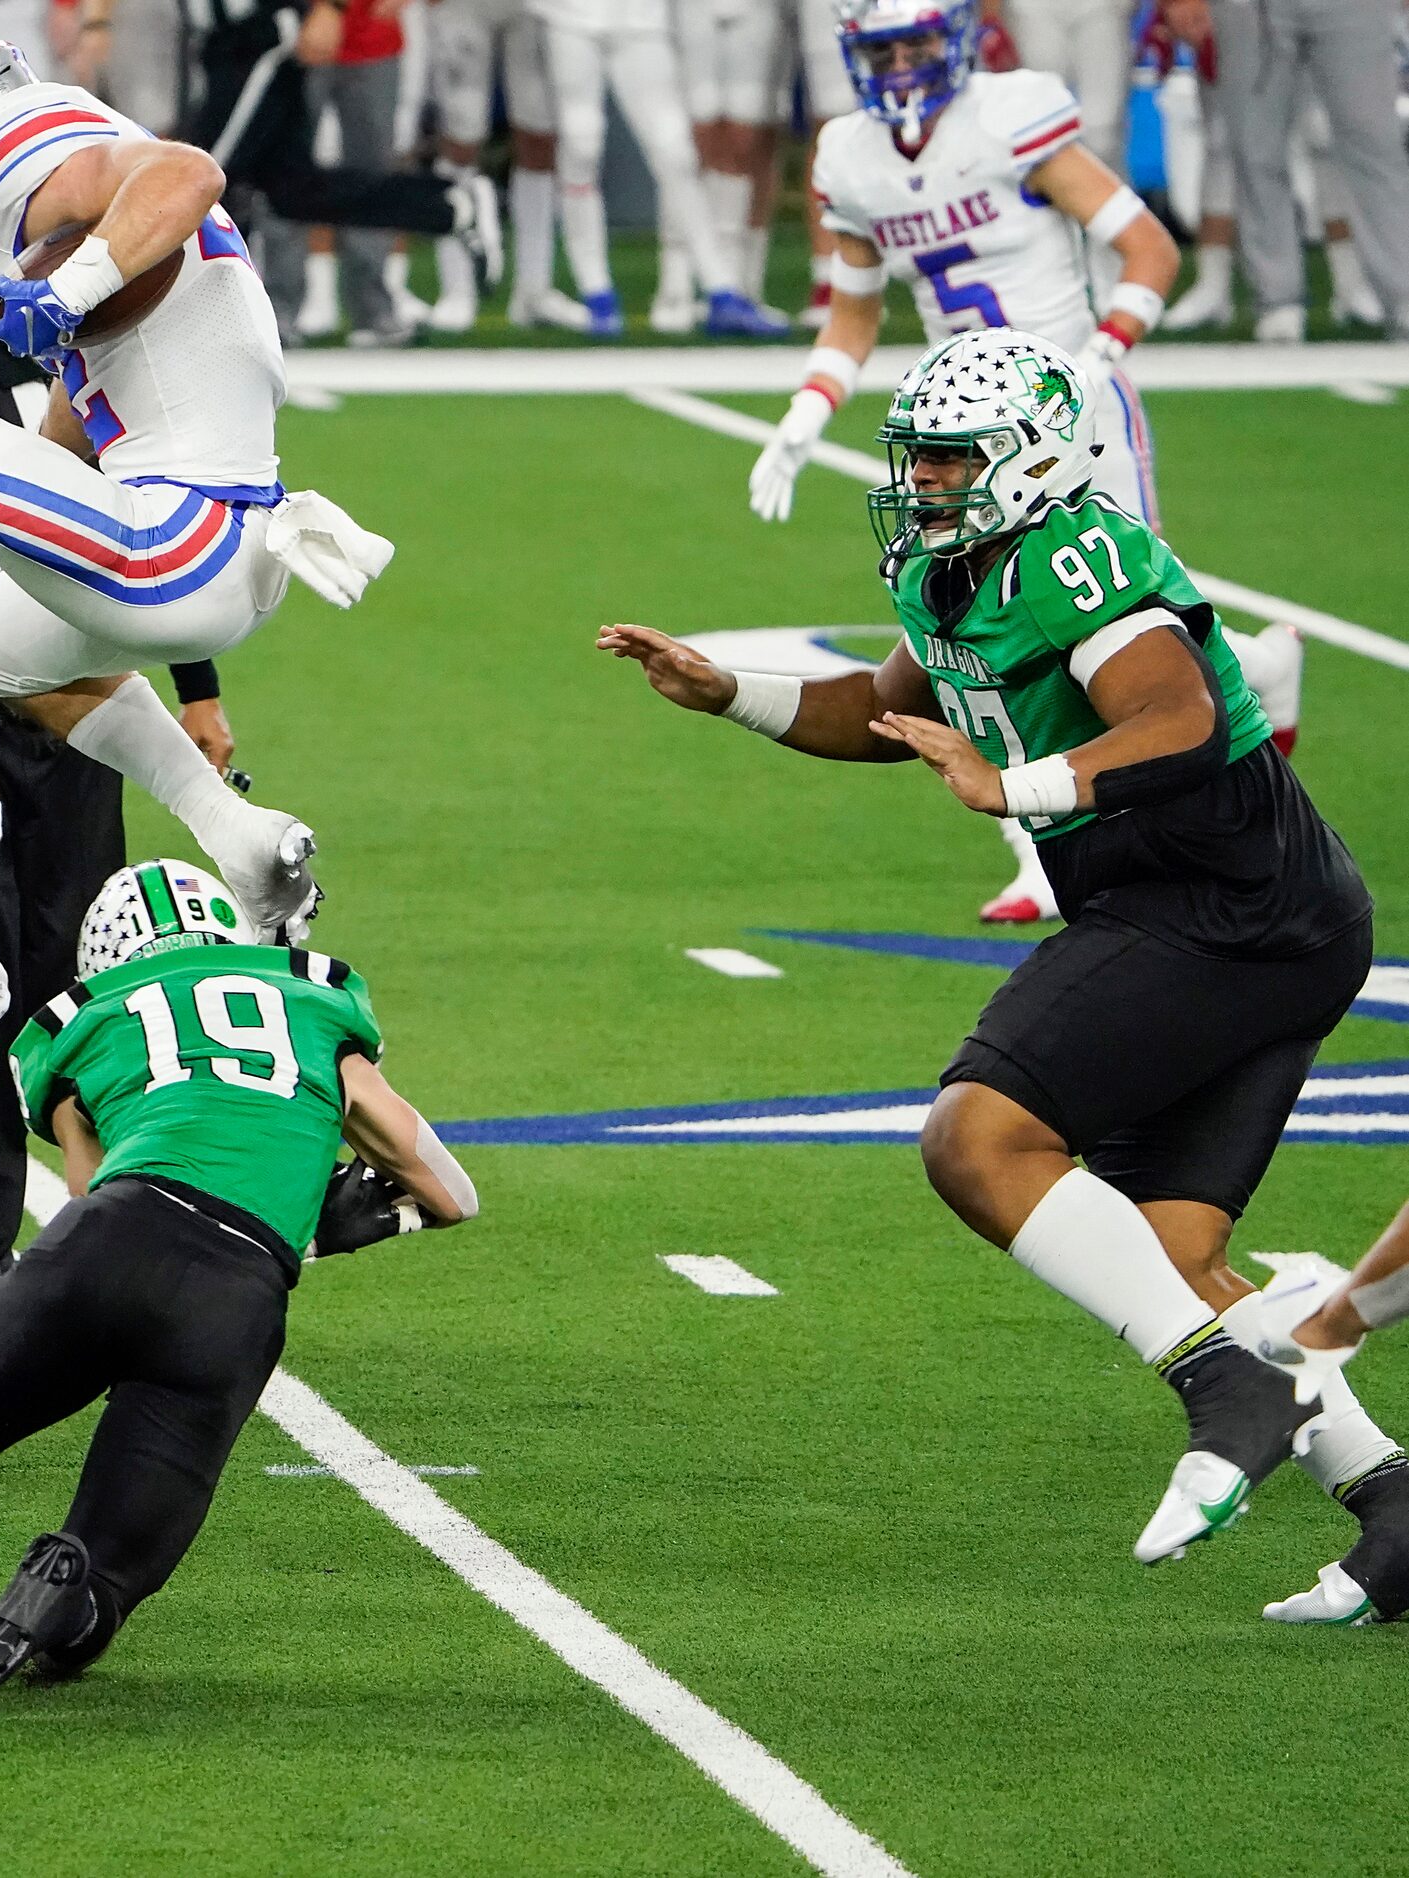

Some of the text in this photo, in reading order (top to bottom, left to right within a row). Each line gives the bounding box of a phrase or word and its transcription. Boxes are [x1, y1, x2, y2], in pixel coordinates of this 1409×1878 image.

[914, 242, 1008, 334] 5
[1050, 526, 1131, 613] 97
[924, 634, 1004, 685] DRAGONS
[131, 913, 143, 937] 1
[186, 898, 206, 922] 9
[123, 974, 301, 1101] 19
